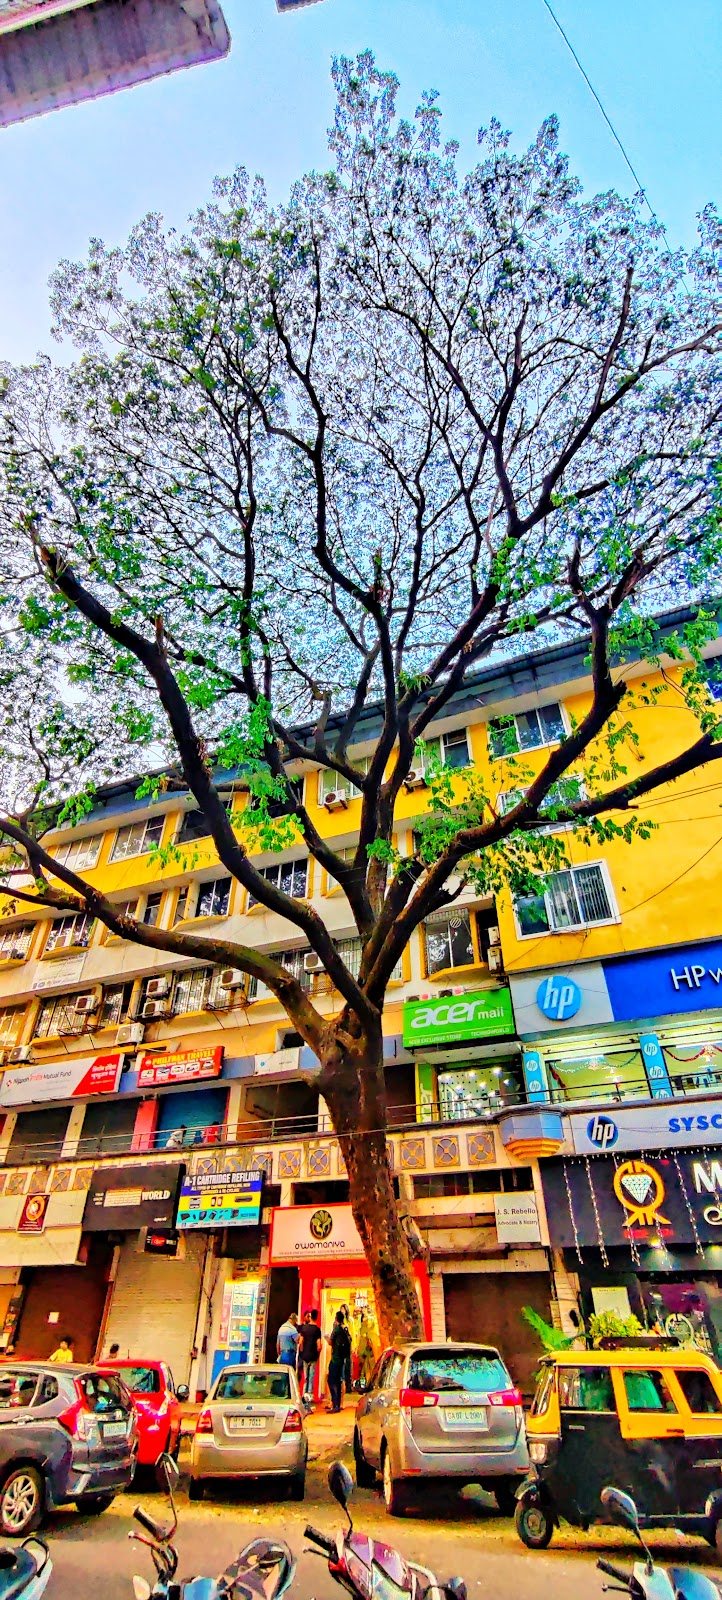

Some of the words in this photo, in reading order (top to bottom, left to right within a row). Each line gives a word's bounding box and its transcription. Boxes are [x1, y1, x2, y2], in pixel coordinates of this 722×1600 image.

[671, 965, 706, 990] HP
[542, 976, 575, 1020] hp
[411, 1000, 486, 1029] acer
[187, 1049, 215, 1060] TRAVELS
[14, 1076, 30, 1085] Nippon
[43, 1071, 59, 1080] Mutual
[59, 1070, 72, 1078] Fund
[668, 1113, 722, 1133] SYSC
[591, 1115, 615, 1150] hp
[184, 1175, 197, 1187] A-1
[197, 1173, 231, 1186] CARTRIDGE
[231, 1171, 260, 1183] REFILING
[142, 1189, 171, 1201] WORLD
[511, 1207, 536, 1215] Rebello
